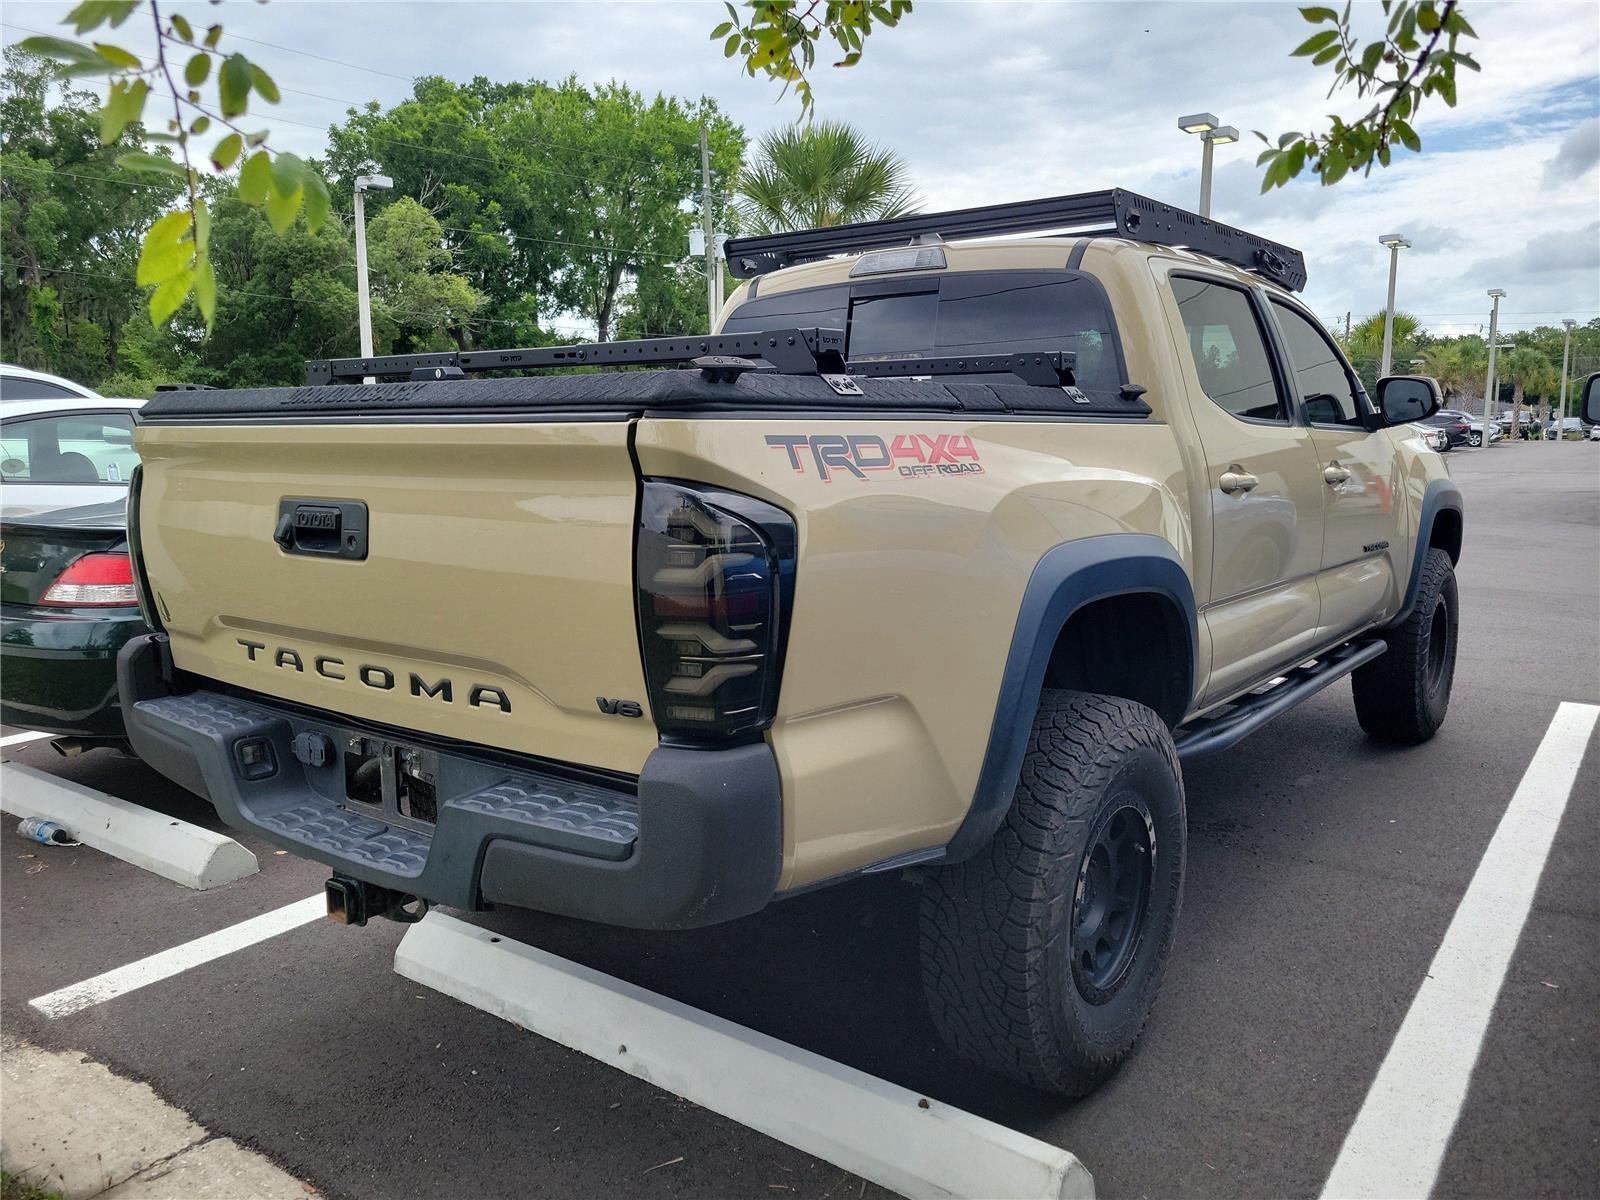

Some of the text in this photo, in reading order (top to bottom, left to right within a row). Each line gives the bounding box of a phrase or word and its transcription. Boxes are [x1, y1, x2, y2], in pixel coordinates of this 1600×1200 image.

[764, 434, 980, 482] TRD 4X4
[898, 463, 984, 478] OFF ROAD
[296, 511, 336, 528] TOYOTA
[236, 638, 512, 714] TACOMA
[596, 697, 643, 718] V6
